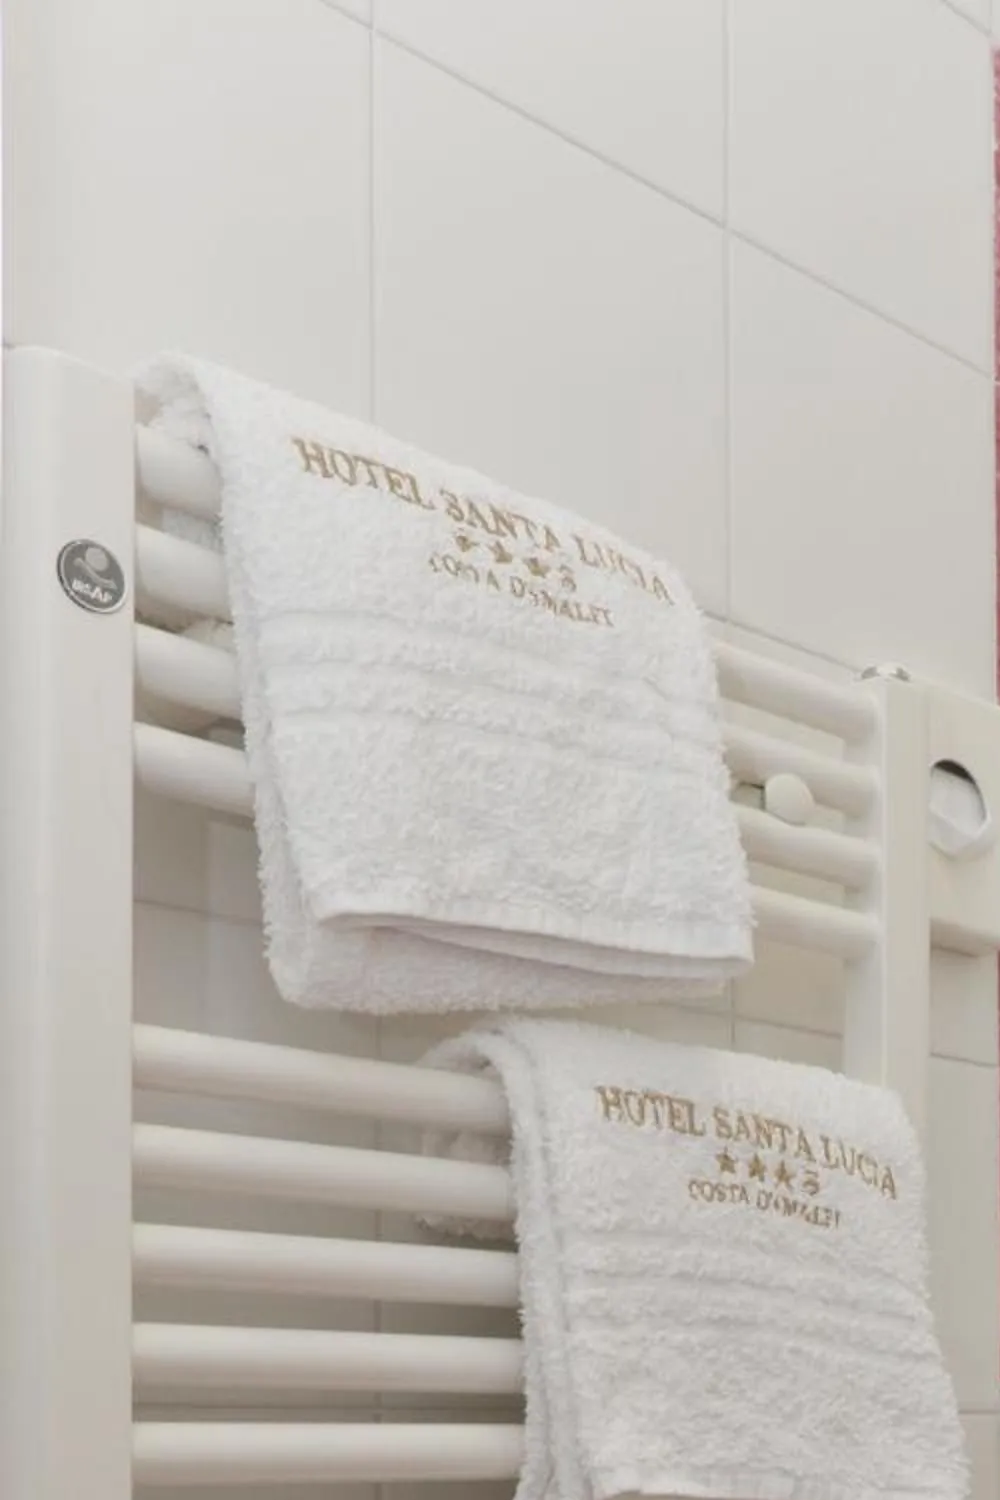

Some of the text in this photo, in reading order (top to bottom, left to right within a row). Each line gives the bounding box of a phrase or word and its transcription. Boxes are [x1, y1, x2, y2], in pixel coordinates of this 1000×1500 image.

[291, 436, 674, 606] HOTEL SANTA LUCIA
[595, 1085, 897, 1201] HOTEL SANTA LUCIA
[688, 1178, 750, 1206] COSTA
